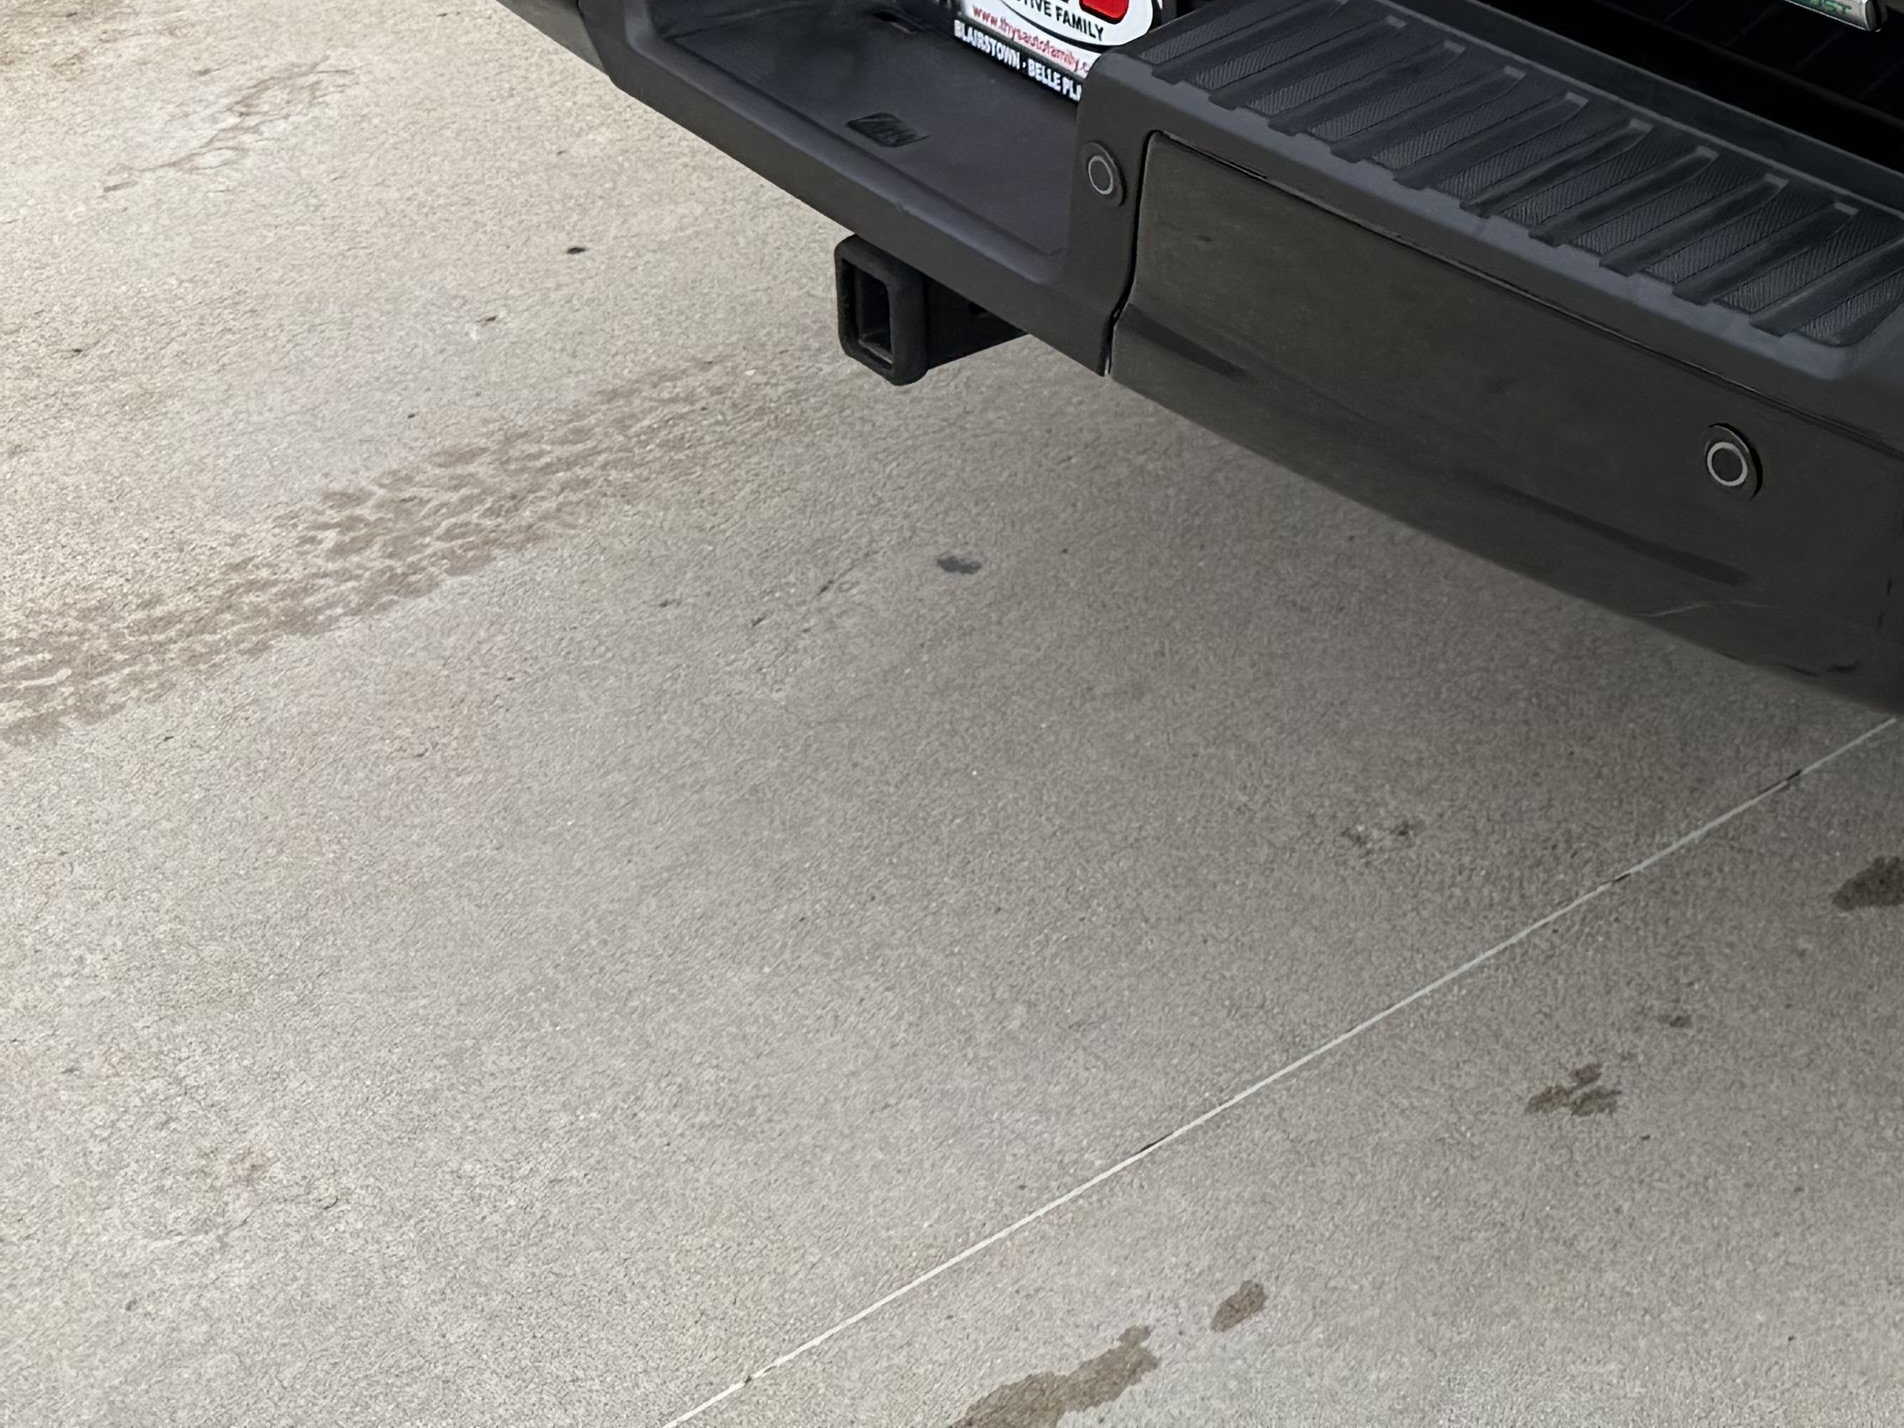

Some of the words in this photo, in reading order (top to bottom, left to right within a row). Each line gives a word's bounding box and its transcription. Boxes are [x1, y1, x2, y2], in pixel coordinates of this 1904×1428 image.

[1055, 5, 1105, 43] FAMILY
[953, 18, 1021, 71] BLAIRSTOWN
[1027, 55, 1063, 91] BELLE
